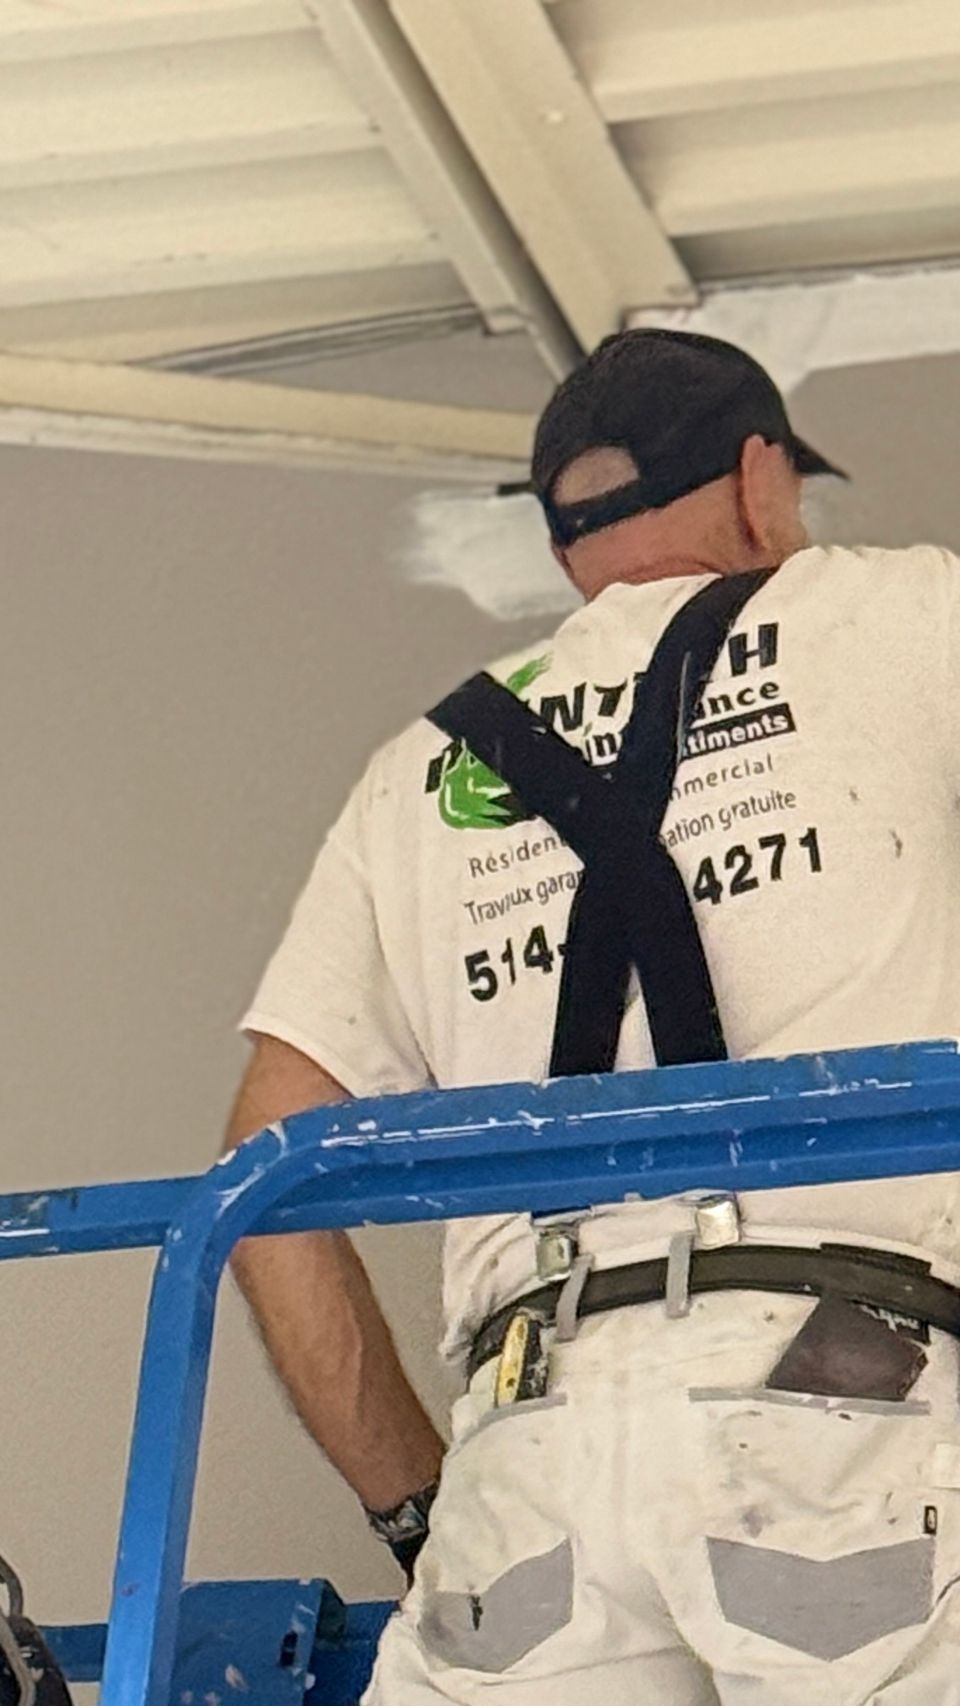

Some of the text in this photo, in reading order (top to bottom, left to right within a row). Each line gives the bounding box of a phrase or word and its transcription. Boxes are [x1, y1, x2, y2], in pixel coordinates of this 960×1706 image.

[685, 714, 790, 755] timents
[469, 752, 774, 879] Résiden mercial
[718, 789, 798, 832] gratuite
